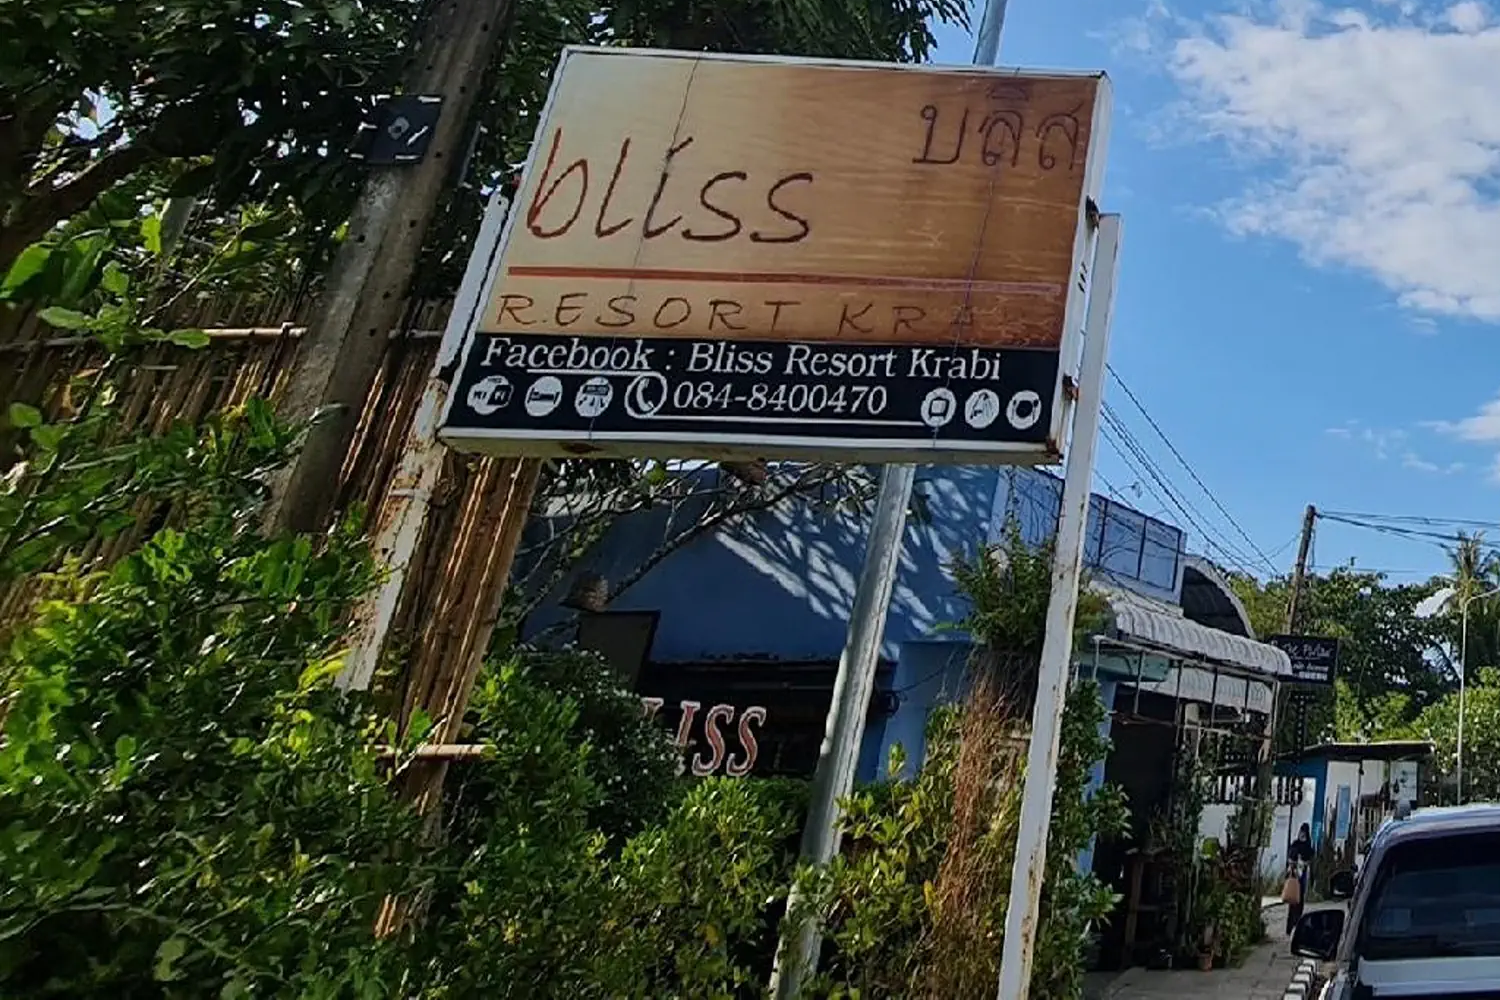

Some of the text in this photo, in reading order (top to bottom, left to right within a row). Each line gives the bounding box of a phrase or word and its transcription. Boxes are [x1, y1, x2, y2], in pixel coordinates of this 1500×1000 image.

[527, 128, 813, 243] bliss
[497, 292, 801, 331] RESORT
[480, 337, 655, 370] Facebook
[686, 342, 773, 374] Bliss
[784, 344, 896, 377] Resort
[907, 347, 1001, 380] Krabi
[673, 381, 888, 414] 084-8400470
